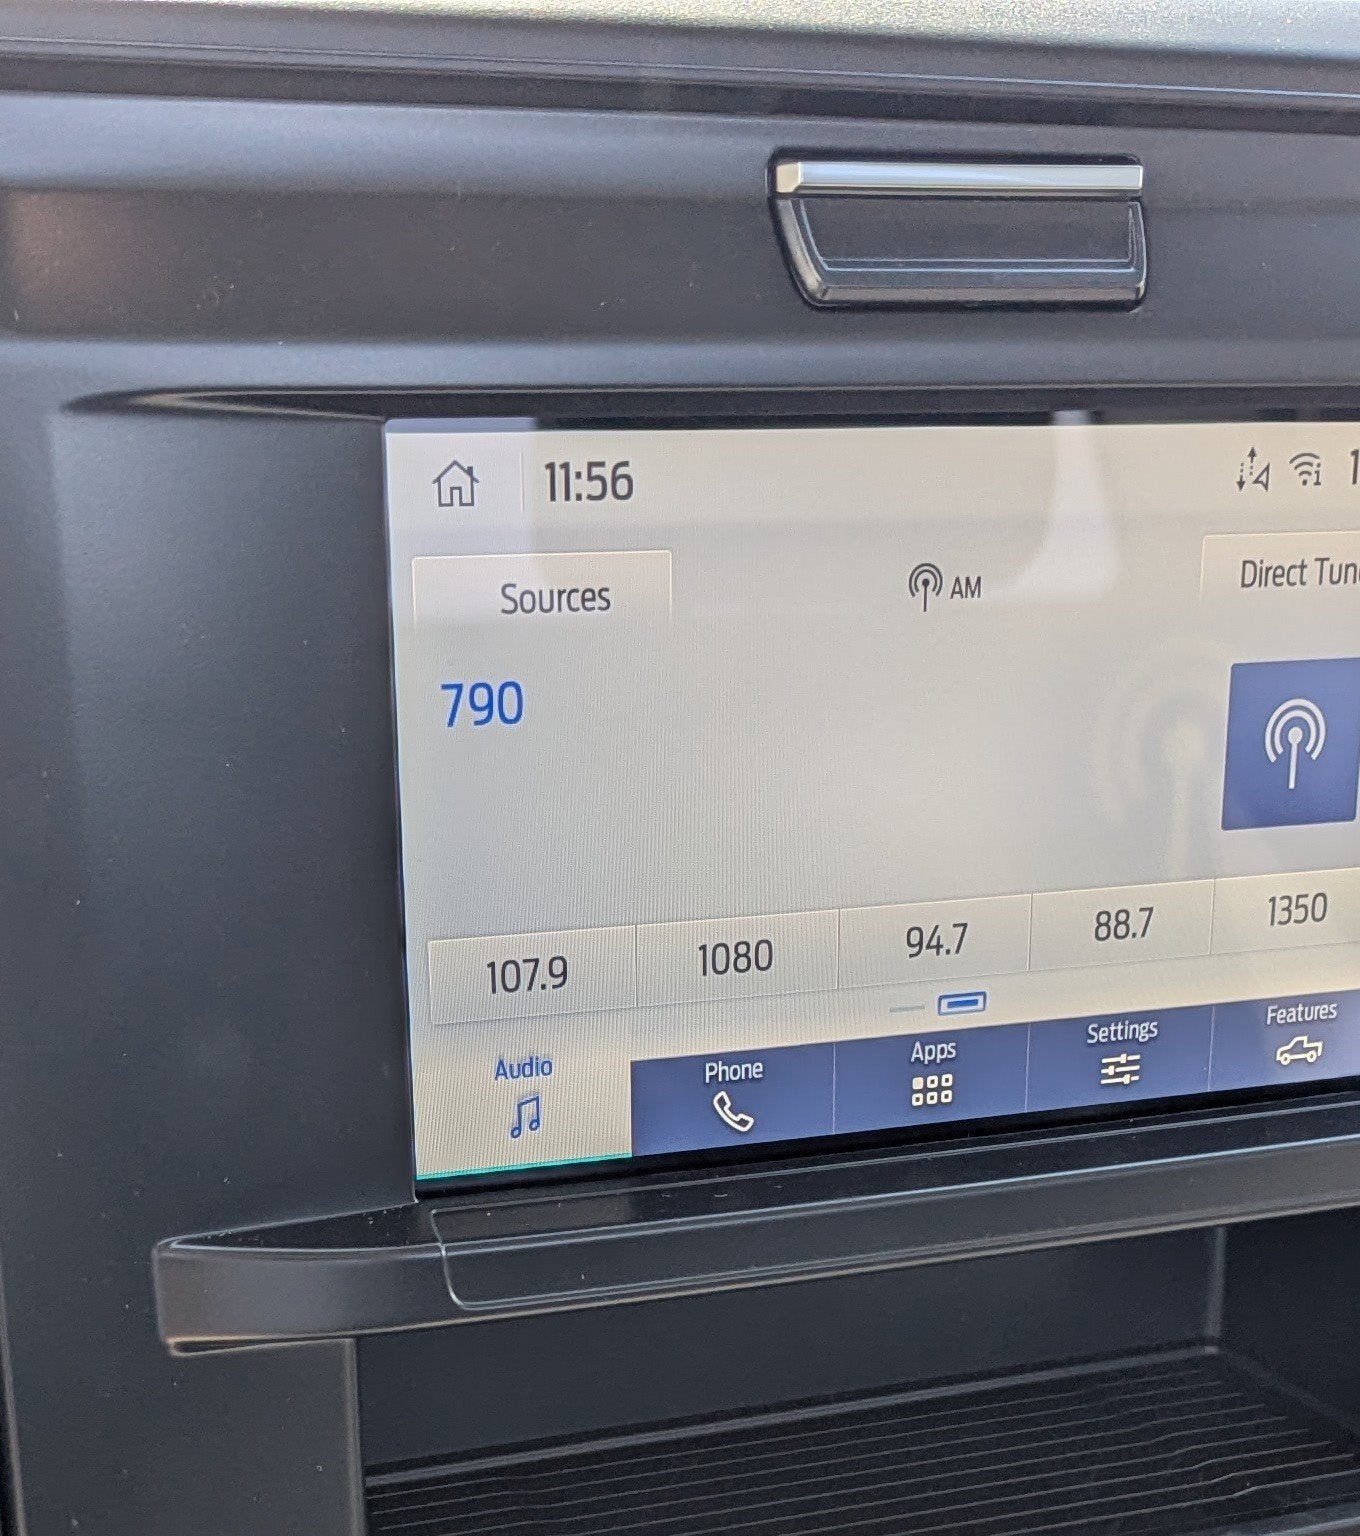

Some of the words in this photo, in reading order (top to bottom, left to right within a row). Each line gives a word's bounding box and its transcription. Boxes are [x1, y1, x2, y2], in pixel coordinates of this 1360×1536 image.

[545, 460, 634, 502] 11:56
[949, 575, 982, 599] AM
[1240, 557, 1306, 588] Direct
[501, 582, 611, 614] Sources
[441, 680, 524, 727] 790
[1094, 906, 1154, 942] 88.7
[1267, 892, 1328, 926] 1350
[906, 923, 968, 958] 94.7
[698, 939, 774, 977] 1080
[486, 955, 569, 995] 107.9
[1266, 1001, 1338, 1026] Features
[1086, 1020, 1159, 1047] Settings
[494, 1055, 554, 1081] Audio
[911, 1039, 957, 1065] Apps
[705, 1060, 765, 1083] Phone
